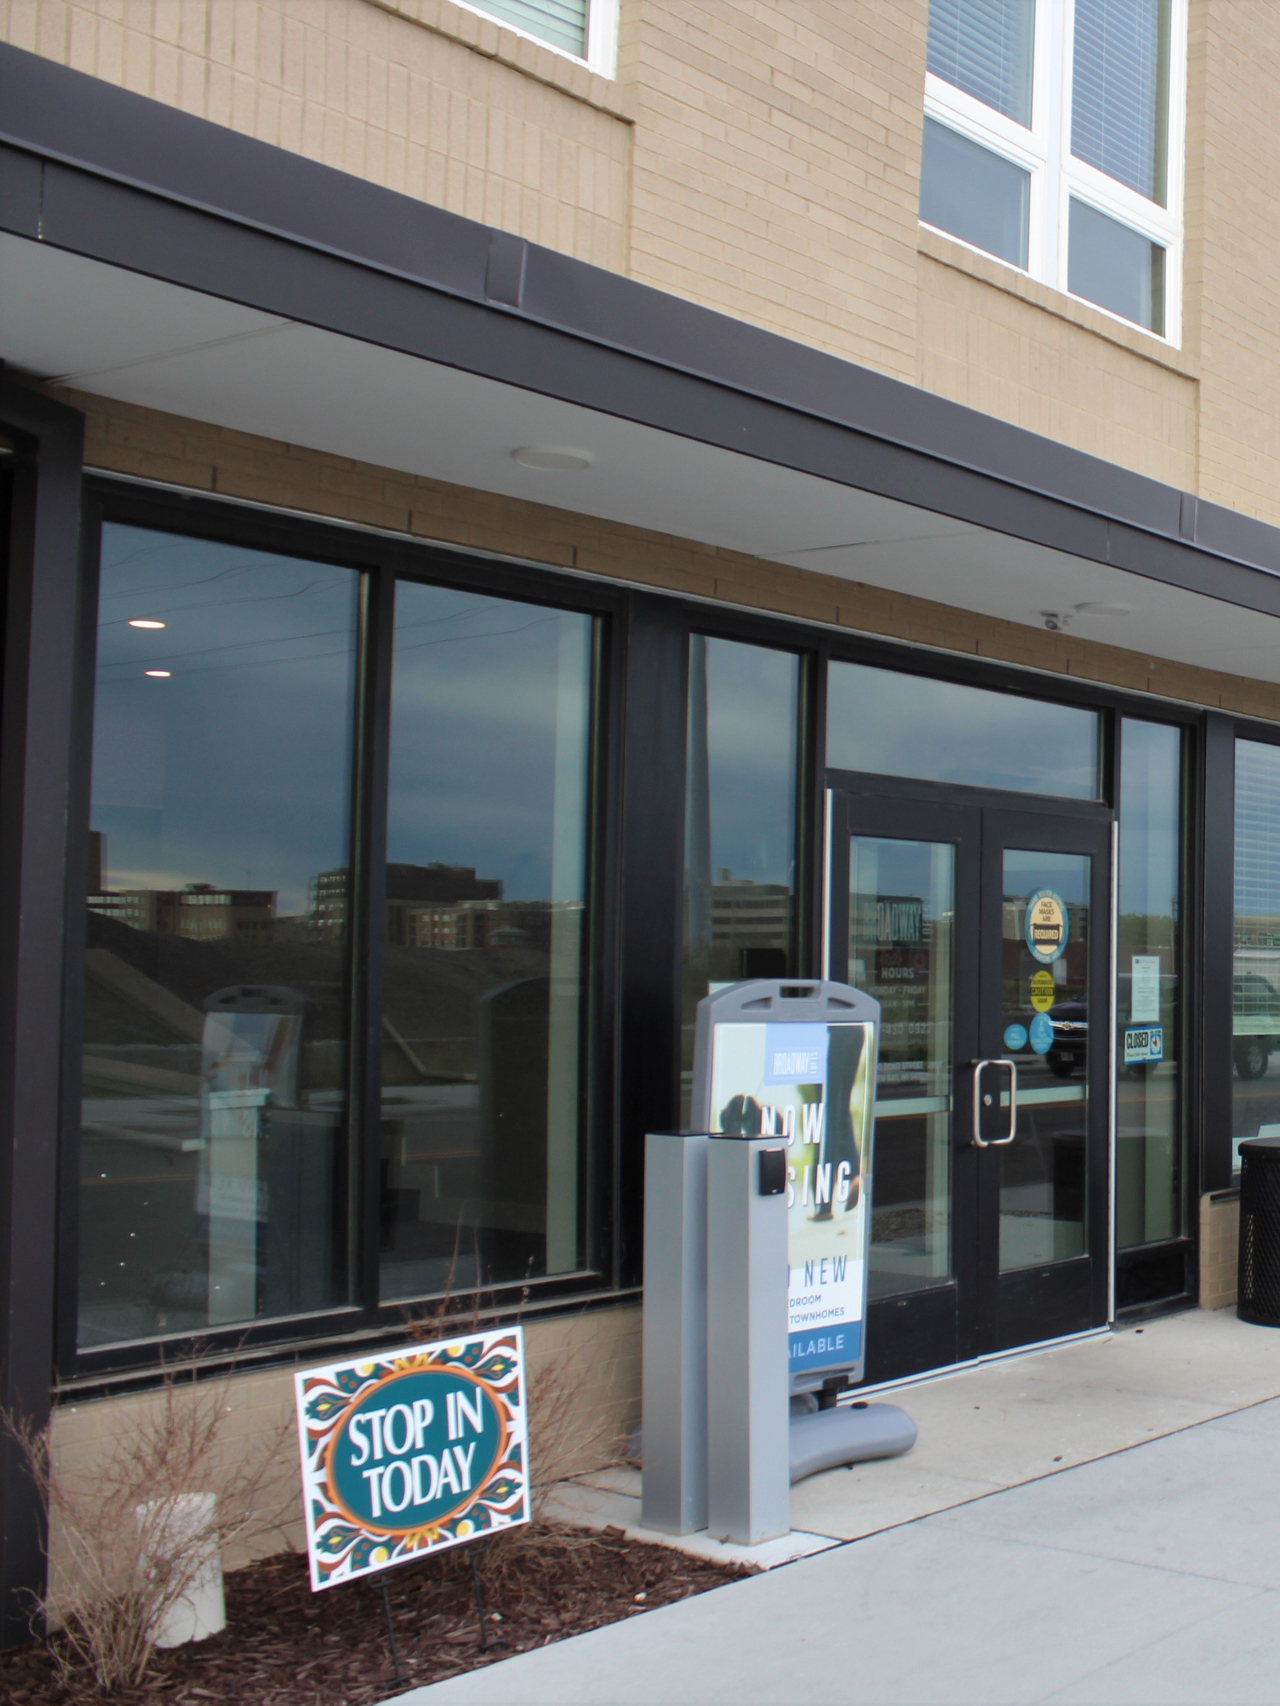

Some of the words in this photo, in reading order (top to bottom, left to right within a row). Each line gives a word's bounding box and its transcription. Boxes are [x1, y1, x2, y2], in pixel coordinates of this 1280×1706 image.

[864, 902, 922, 942] OADWAY
[881, 967, 915, 979] HOURS
[1031, 987, 1053, 995] CAUTION
[1126, 1031, 1149, 1049] CLOSED
[773, 1052, 810, 1075] BROADWAY
[810, 1051, 818, 1074] LOFTS
[761, 1102, 824, 1147] NOW
[787, 1160, 851, 1208] SING
[804, 1254, 847, 1288] NEW
[789, 1307, 845, 1324] TOWNHOMES
[348, 1398, 435, 1467] STOP
[445, 1385, 484, 1441] IN
[361, 1440, 477, 1518] TODAY
